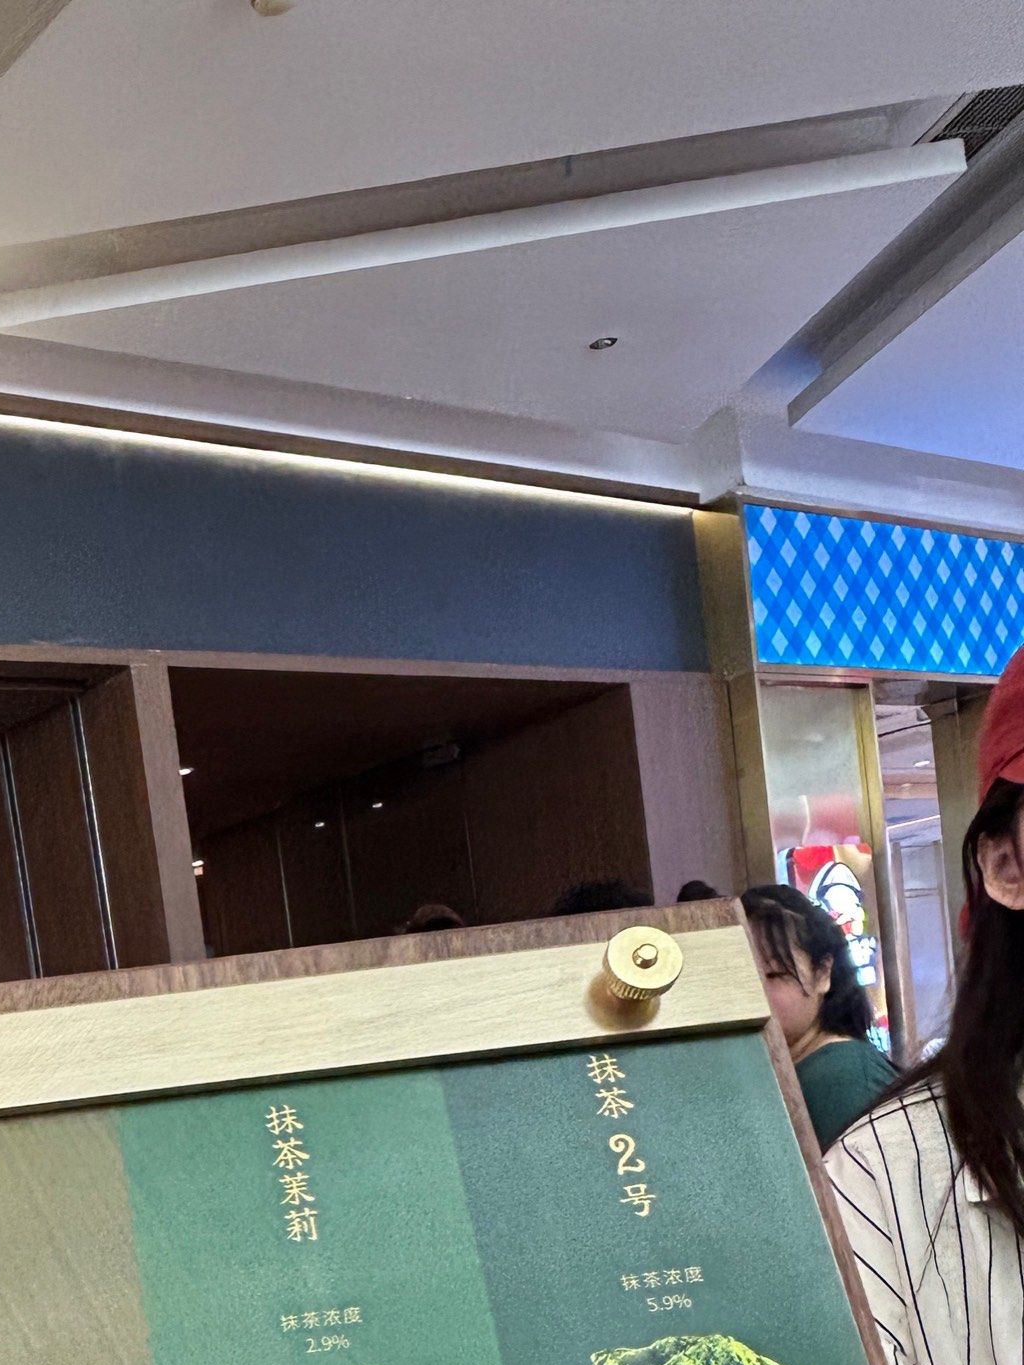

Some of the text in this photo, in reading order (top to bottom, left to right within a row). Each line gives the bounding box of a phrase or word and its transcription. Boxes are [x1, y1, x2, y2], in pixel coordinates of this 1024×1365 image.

[586, 1054, 657, 1217] 抹茶2号
[264, 1105, 319, 1242] 抹茶茉莉
[619, 1265, 705, 1292] 抹茶浓度
[646, 1294, 693, 1313] 5.9%
[279, 1306, 364, 1333] 抹茶浓度
[305, 1334, 351, 1354] 2.9%
